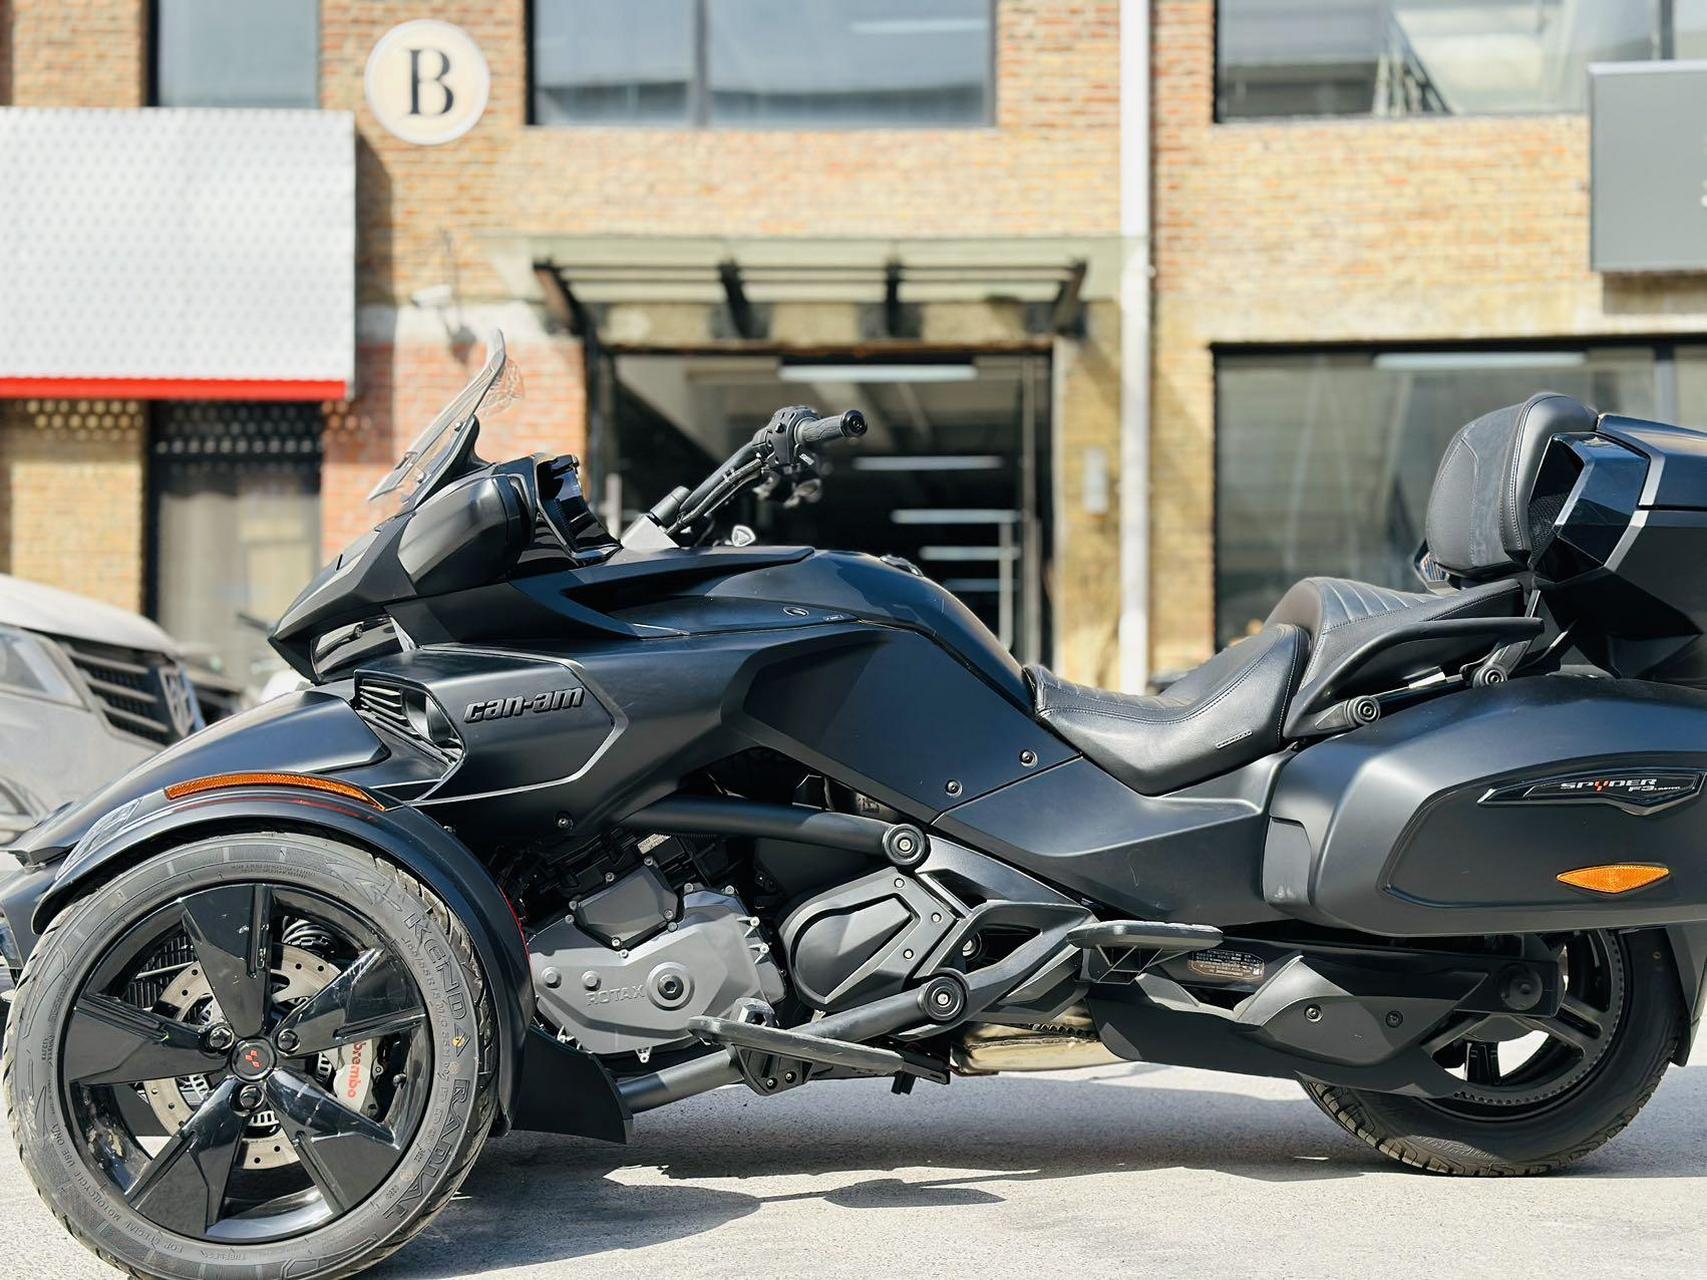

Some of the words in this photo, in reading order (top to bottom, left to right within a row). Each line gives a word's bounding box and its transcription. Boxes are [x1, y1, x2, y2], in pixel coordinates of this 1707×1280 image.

[409, 48, 454, 115] B
[464, 687, 584, 723] can-am
[1560, 778, 1657, 792] SPYDER
[404, 912, 471, 1058] KENDA
[585, 984, 645, 1006] ROTAX
[347, 1041, 367, 1098] brembo
[383, 1079, 471, 1219] RADIAL
